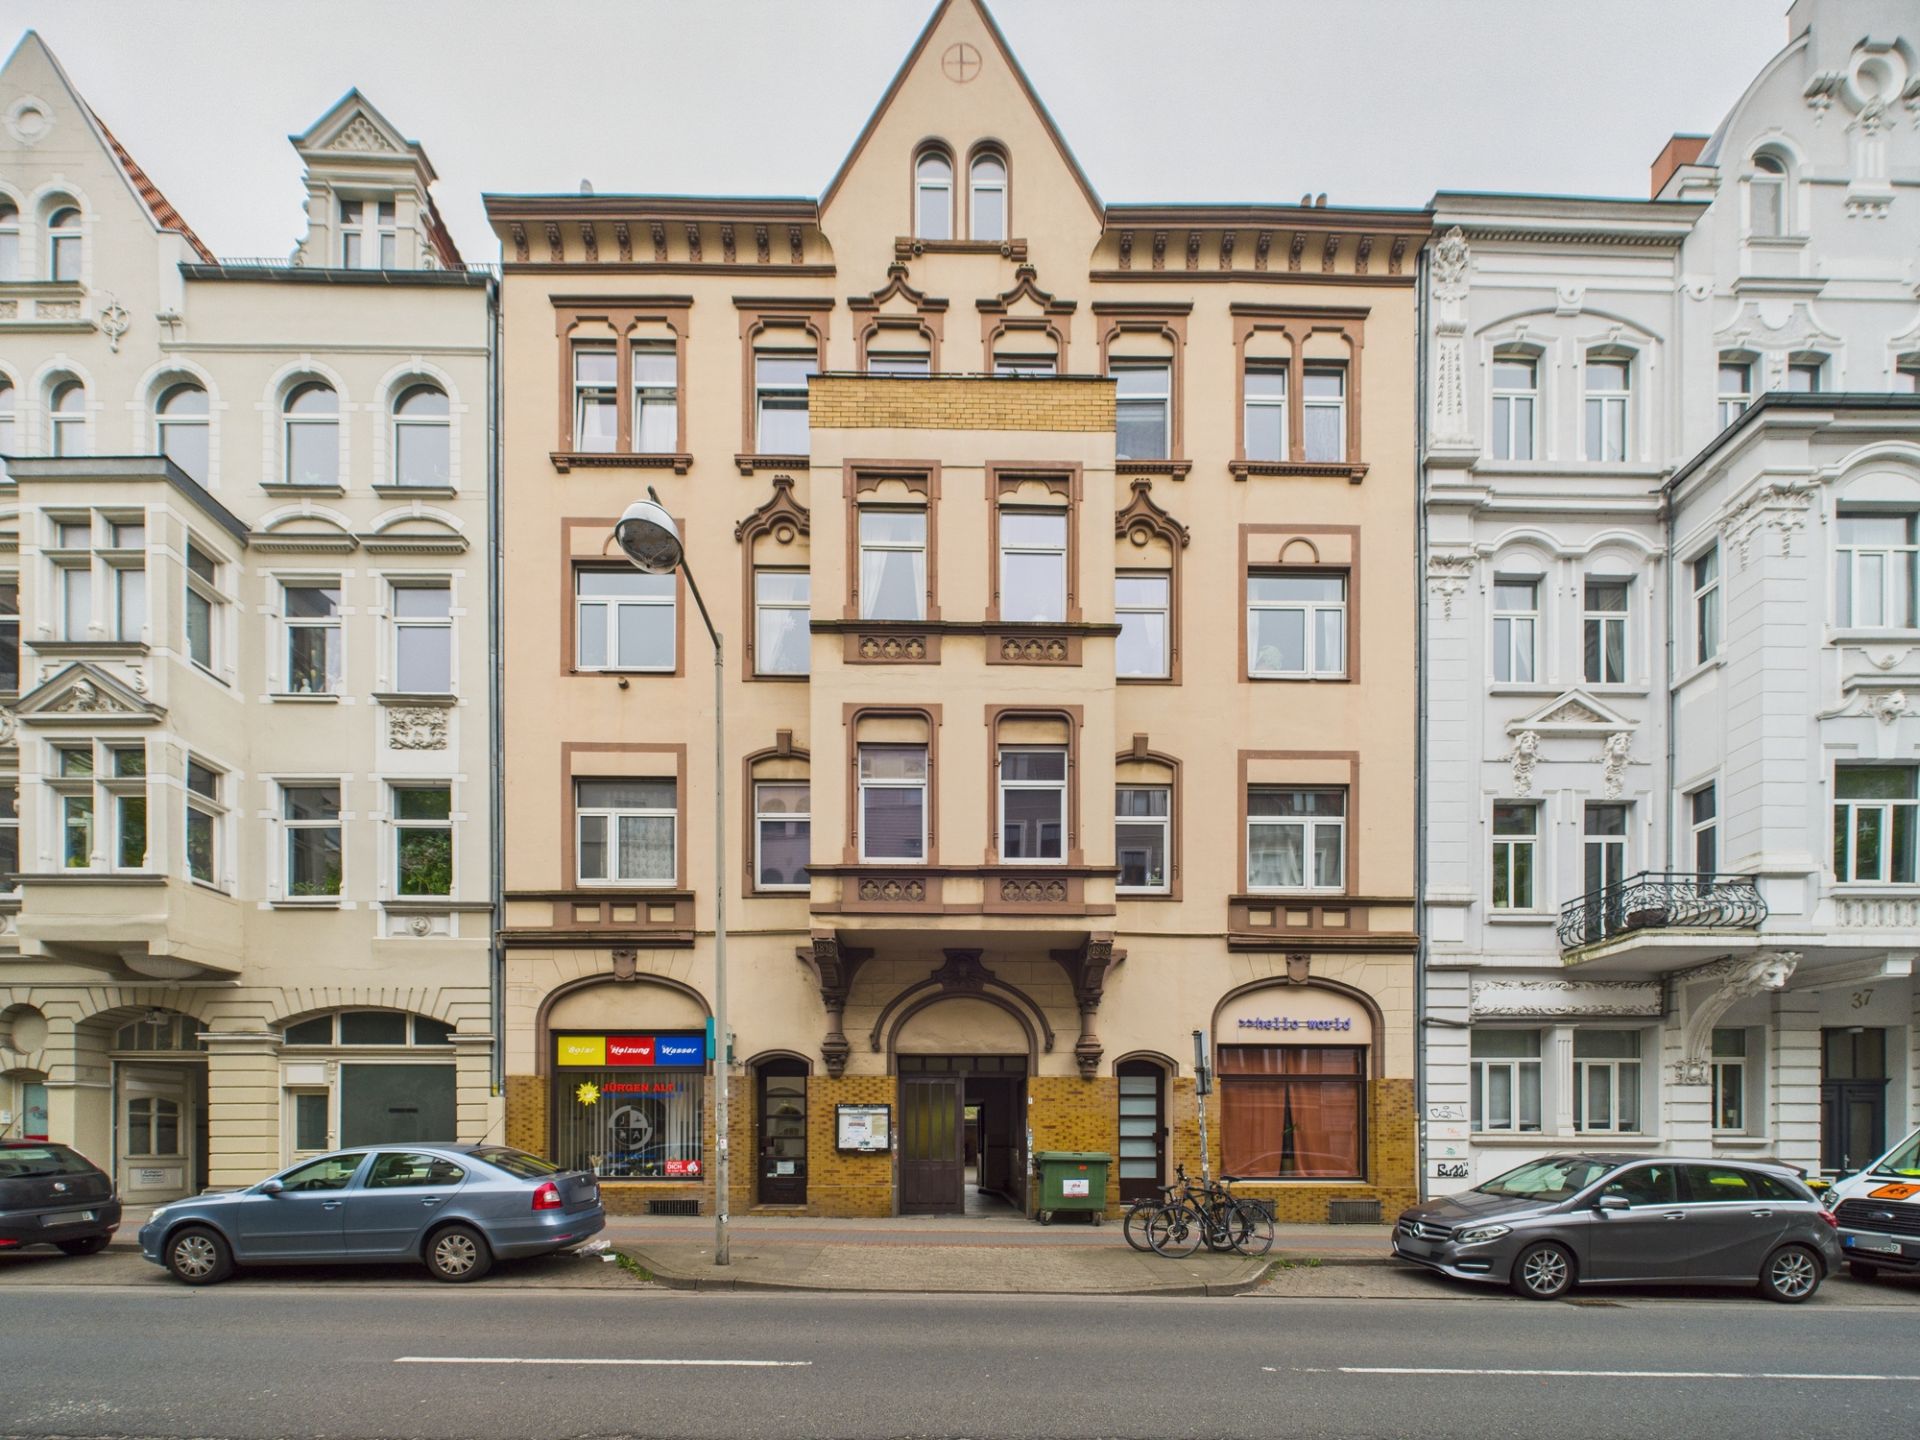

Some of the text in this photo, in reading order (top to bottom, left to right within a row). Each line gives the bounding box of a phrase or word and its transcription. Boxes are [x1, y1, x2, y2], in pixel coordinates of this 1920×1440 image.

[1851, 989, 1874, 1009] 37
[568, 1045, 595, 1056] Solar
[610, 1044, 650, 1056] Heizung
[661, 1045, 697, 1056] Wasser
[602, 1082, 649, 1092] JÜRGEN
